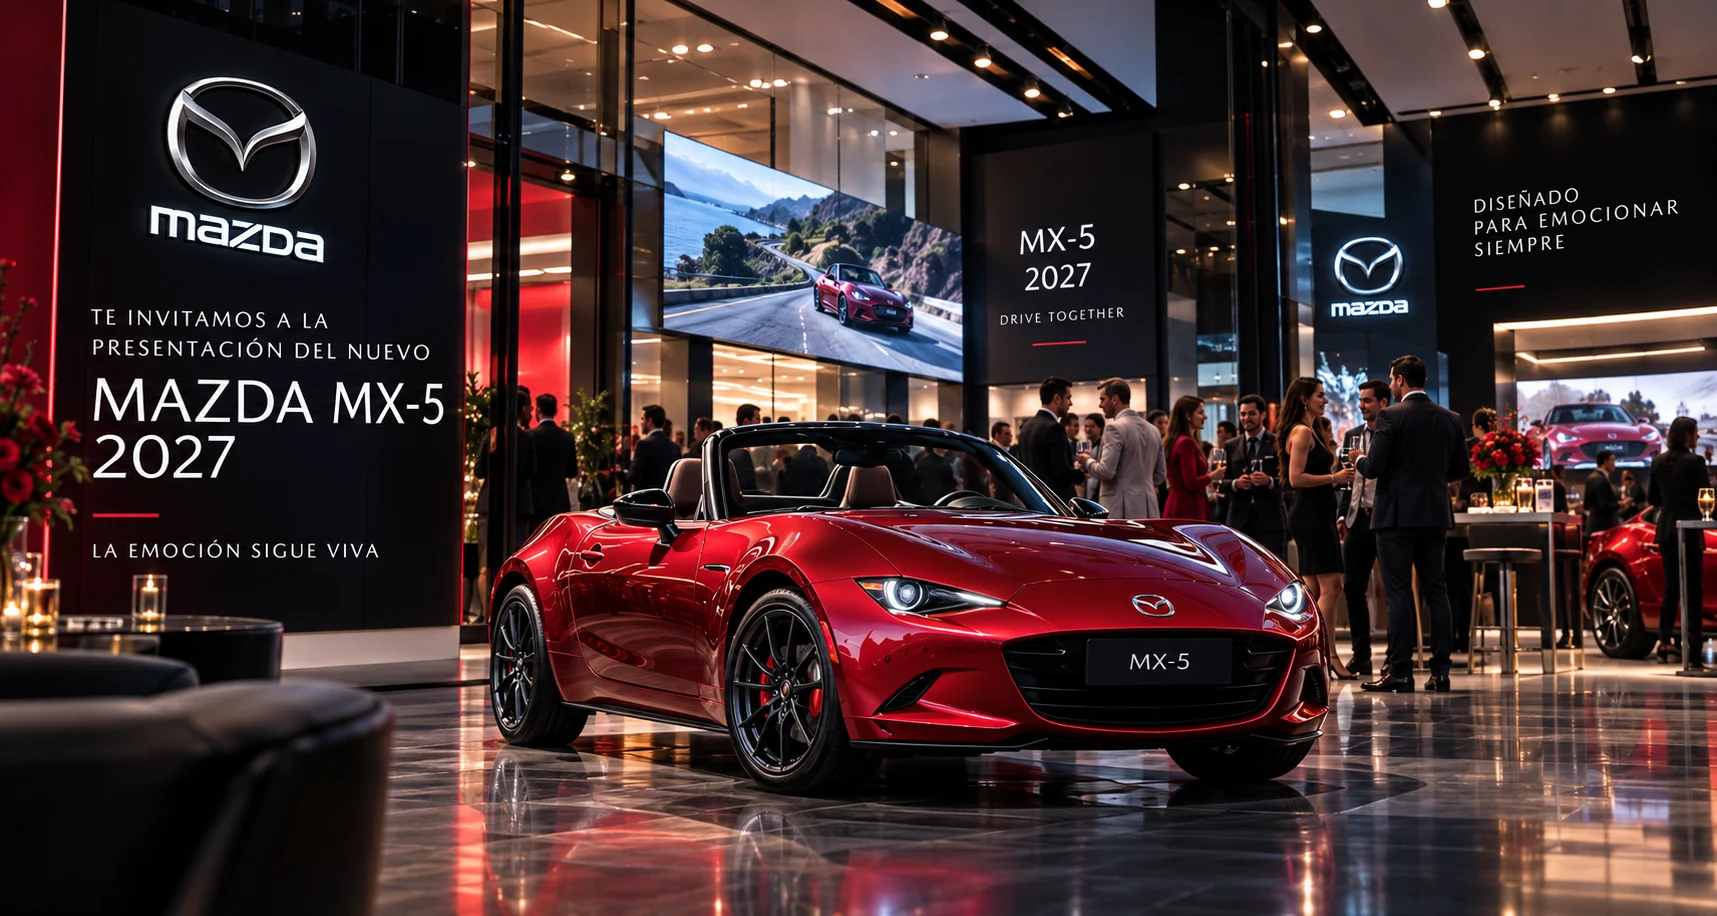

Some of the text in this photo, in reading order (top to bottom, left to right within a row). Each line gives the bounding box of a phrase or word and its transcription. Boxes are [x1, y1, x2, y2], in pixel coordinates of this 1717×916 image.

[1474, 187, 1580, 214] DISEÑADO
[1474, 199, 1679, 236] PARA EMOCIONAR
[1020, 224, 1094, 255] MX-5
[1474, 234, 1565, 257] SIEMPRE
[1025, 263, 1091, 291] 2027
[91, 309, 327, 329] TE INVITAMOS A LA
[1001, 307, 1123, 325] DRIVE TOGETHER
[93, 338, 429, 360] PRESENTACIÓN DEL NUEVO
[94, 378, 443, 424] MAZDA MX-5
[93, 435, 235, 478] 2027
[93, 540, 378, 558] LA EMOCIÓN SIGUE VIVA
[1130, 653, 1189, 670] MX-5
